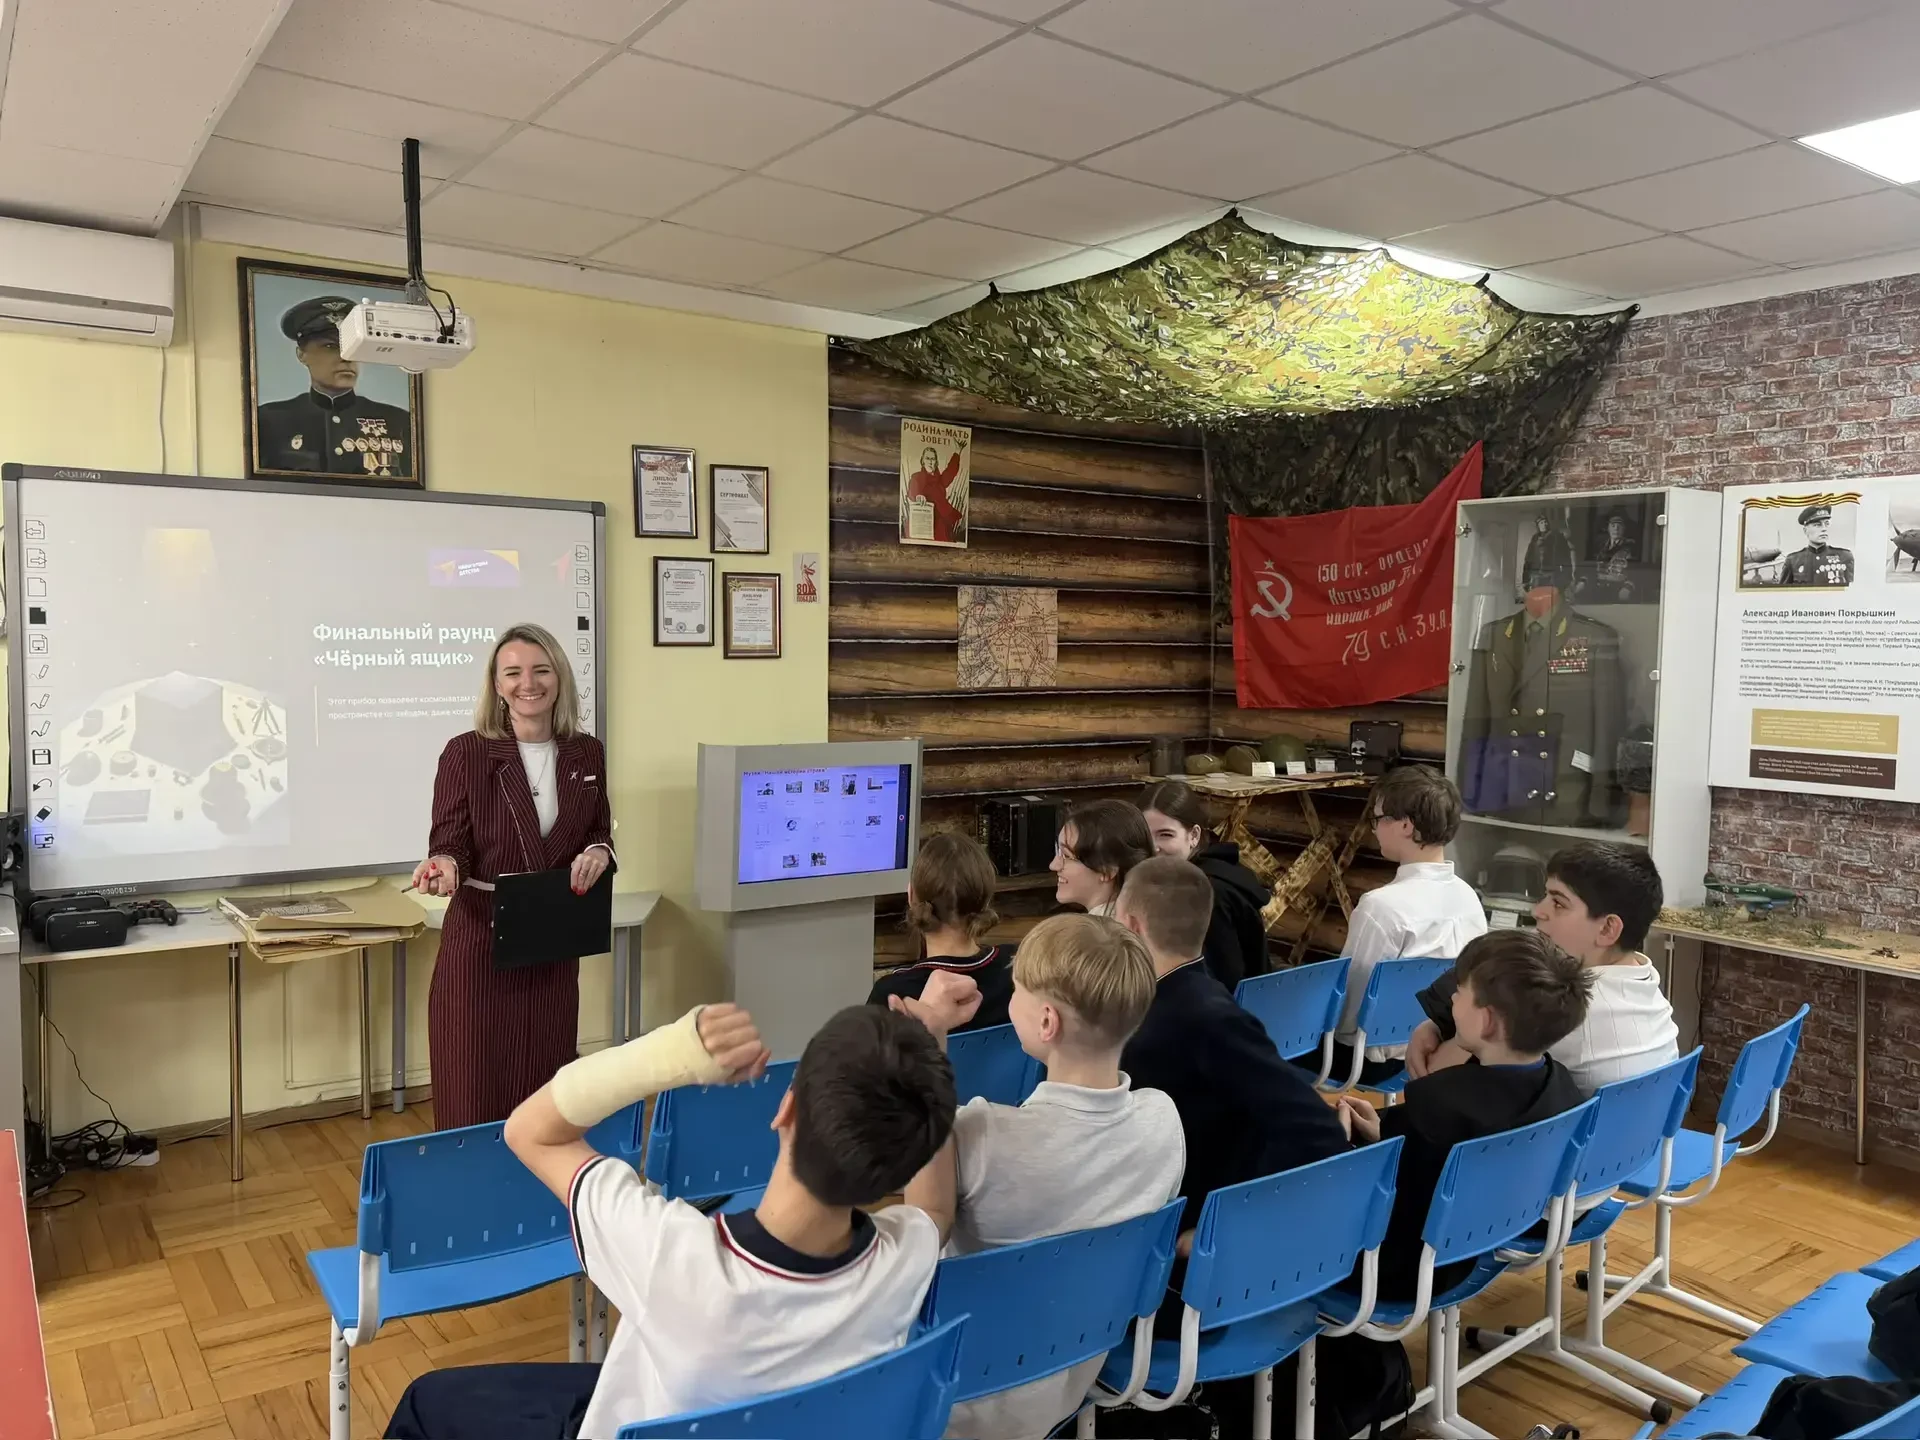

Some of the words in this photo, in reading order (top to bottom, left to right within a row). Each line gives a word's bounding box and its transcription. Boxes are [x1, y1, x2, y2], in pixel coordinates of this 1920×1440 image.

[903, 422, 969, 439] РОДИНА-МАТЬ
[920, 435, 951, 446] ЗОВЕТ!
[1318, 563, 1338, 582] 150
[796, 583, 808, 595] 80
[1743, 609, 1789, 618] Александр
[1791, 609, 1836, 617] Иванович
[1838, 609, 1896, 618] Покрышкин
[313, 623, 433, 642] Финальный
[438, 627, 497, 644] раунд
[1342, 630, 1370, 665] 79
[314, 649, 405, 670] «Чёрный
[410, 651, 474, 667] ящик»
[328, 697, 346, 705] Этот
[348, 697, 376, 706] прибор
